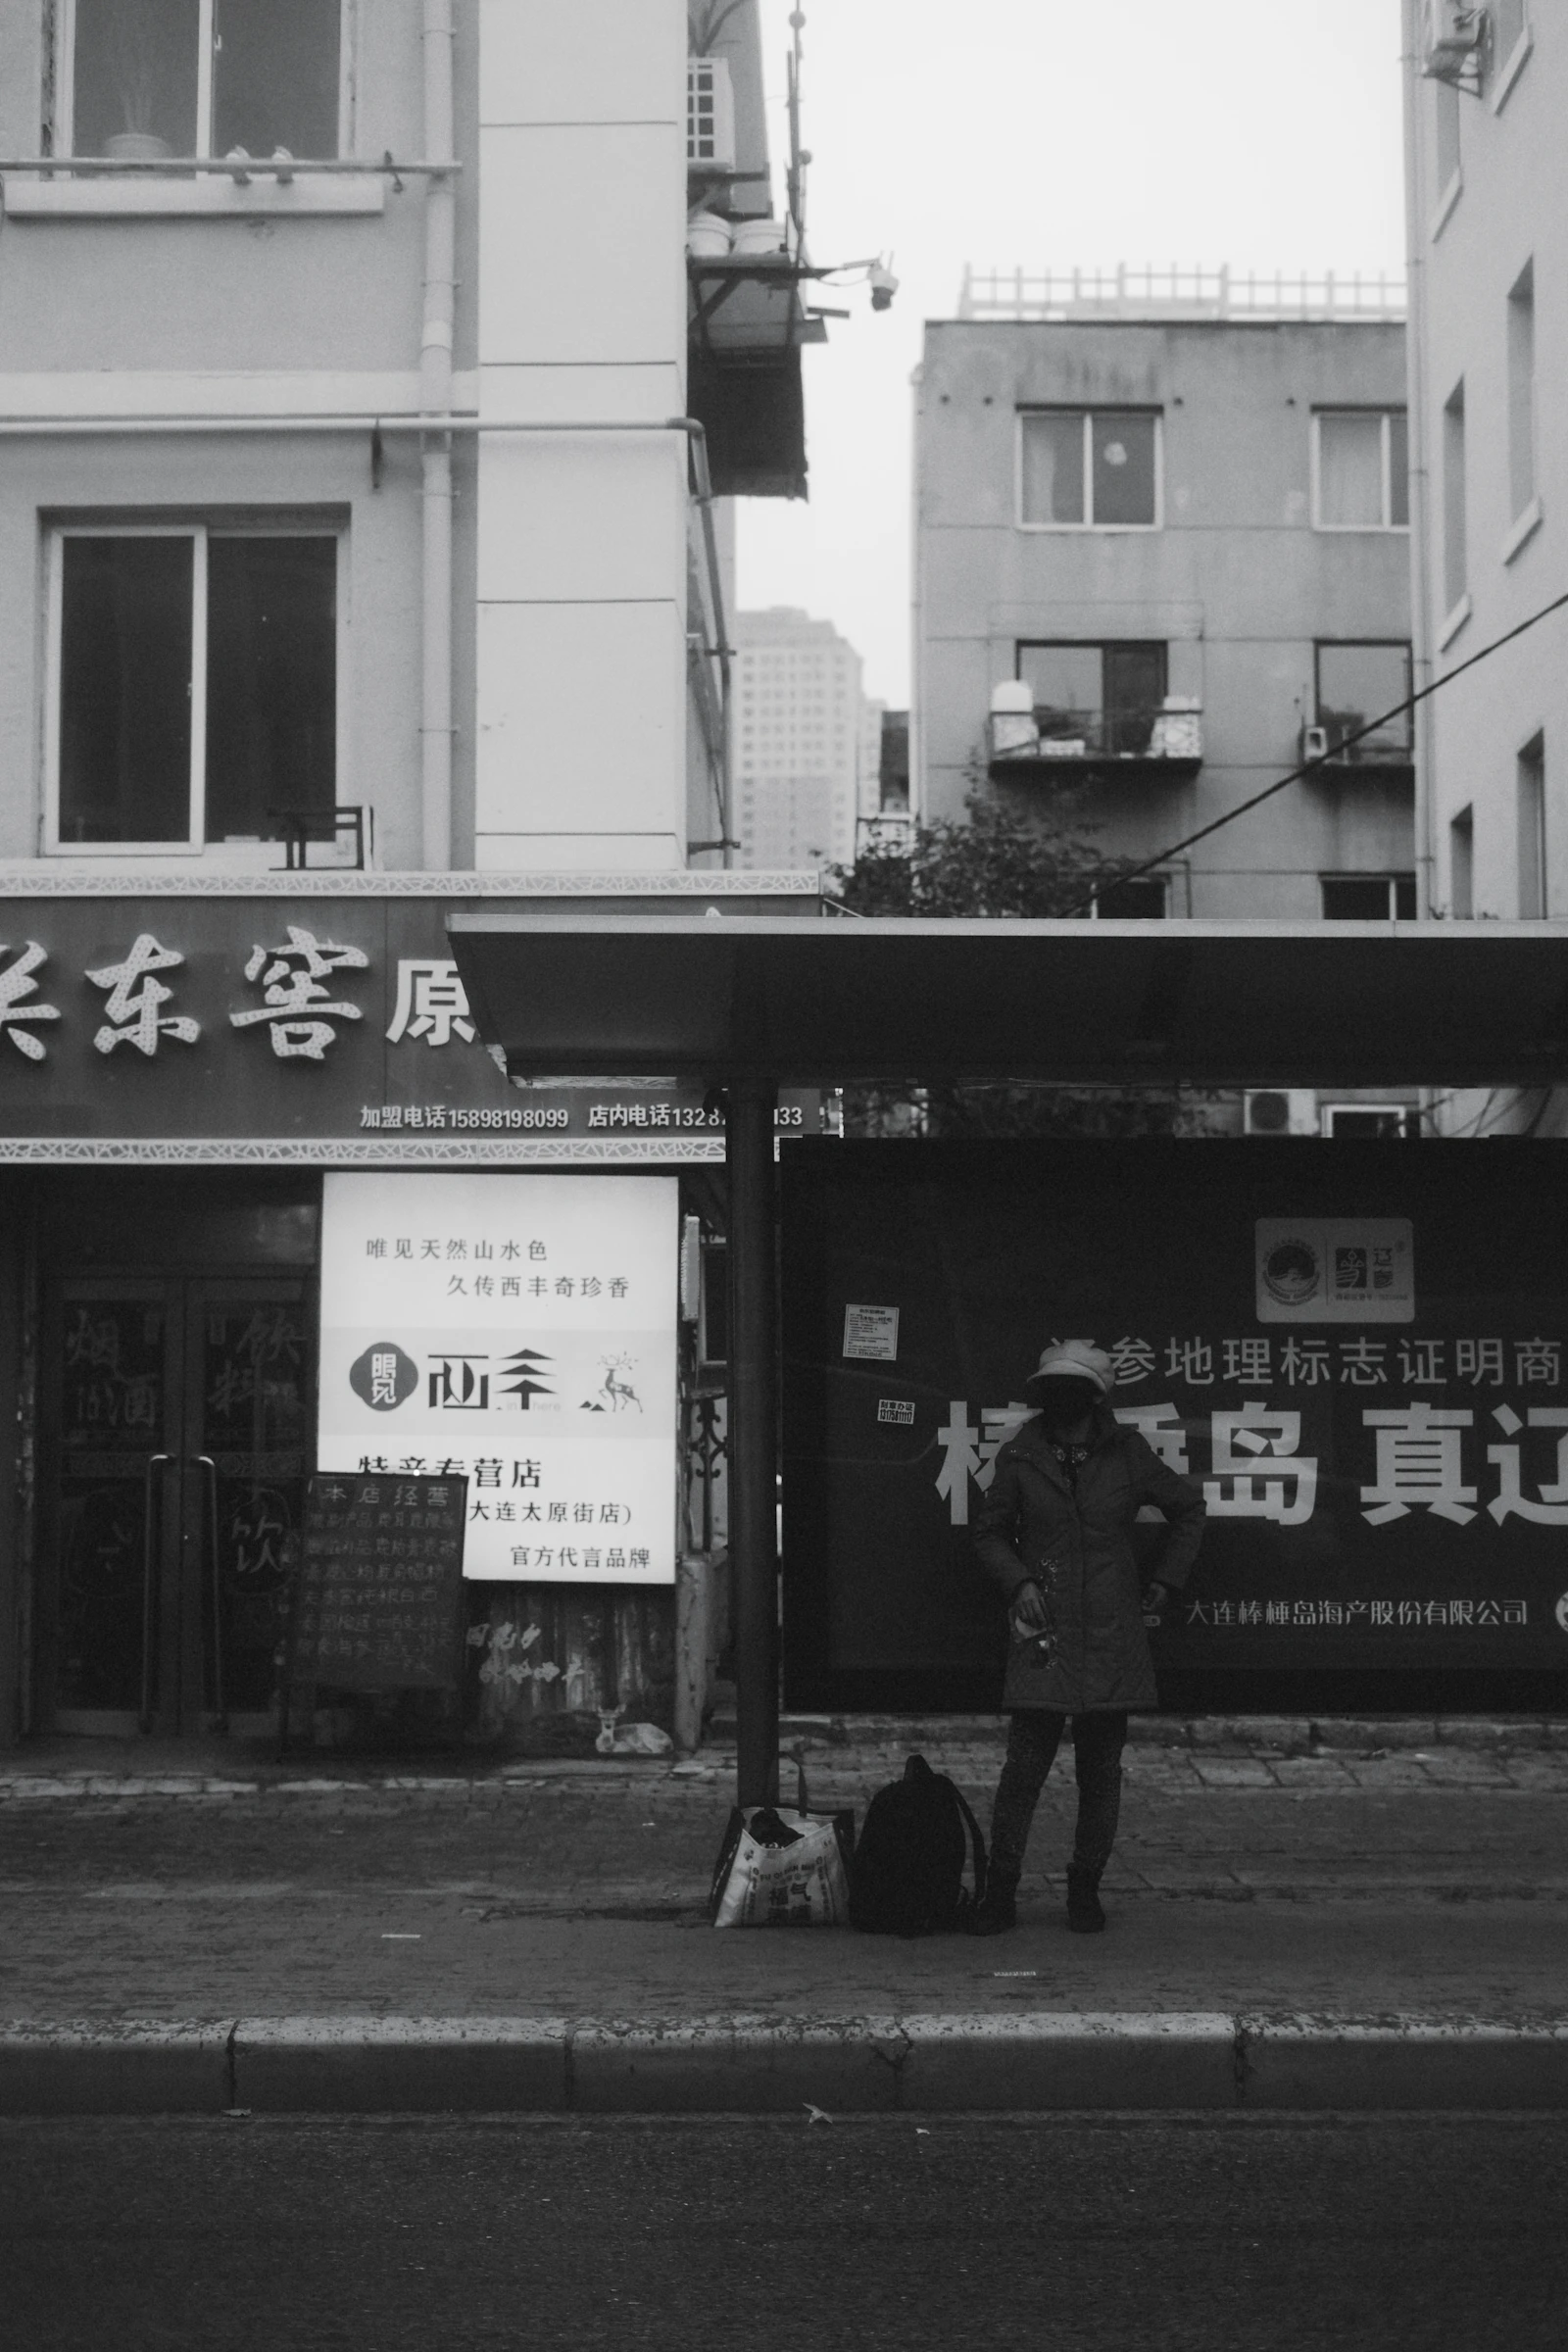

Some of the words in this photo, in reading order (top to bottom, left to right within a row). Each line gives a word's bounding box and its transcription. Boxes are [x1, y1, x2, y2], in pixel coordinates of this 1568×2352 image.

[360, 1105, 569, 1129] 加盟电话15898198099
[588, 1104, 803, 1128] 店内电话1328133
[367, 1238, 548, 1261] 唯见天然山水色
[447, 1274, 628, 1298] 久传西丰奇珍香
[1051, 1335, 1564, 1386] 参地理标志证明商
[321, 1483, 450, 1507] 本店经营
[511, 1545, 651, 1569] 官方代言品牌
[1186, 1599, 1528, 1626] 大连棒棰岛海产股份有限公司
